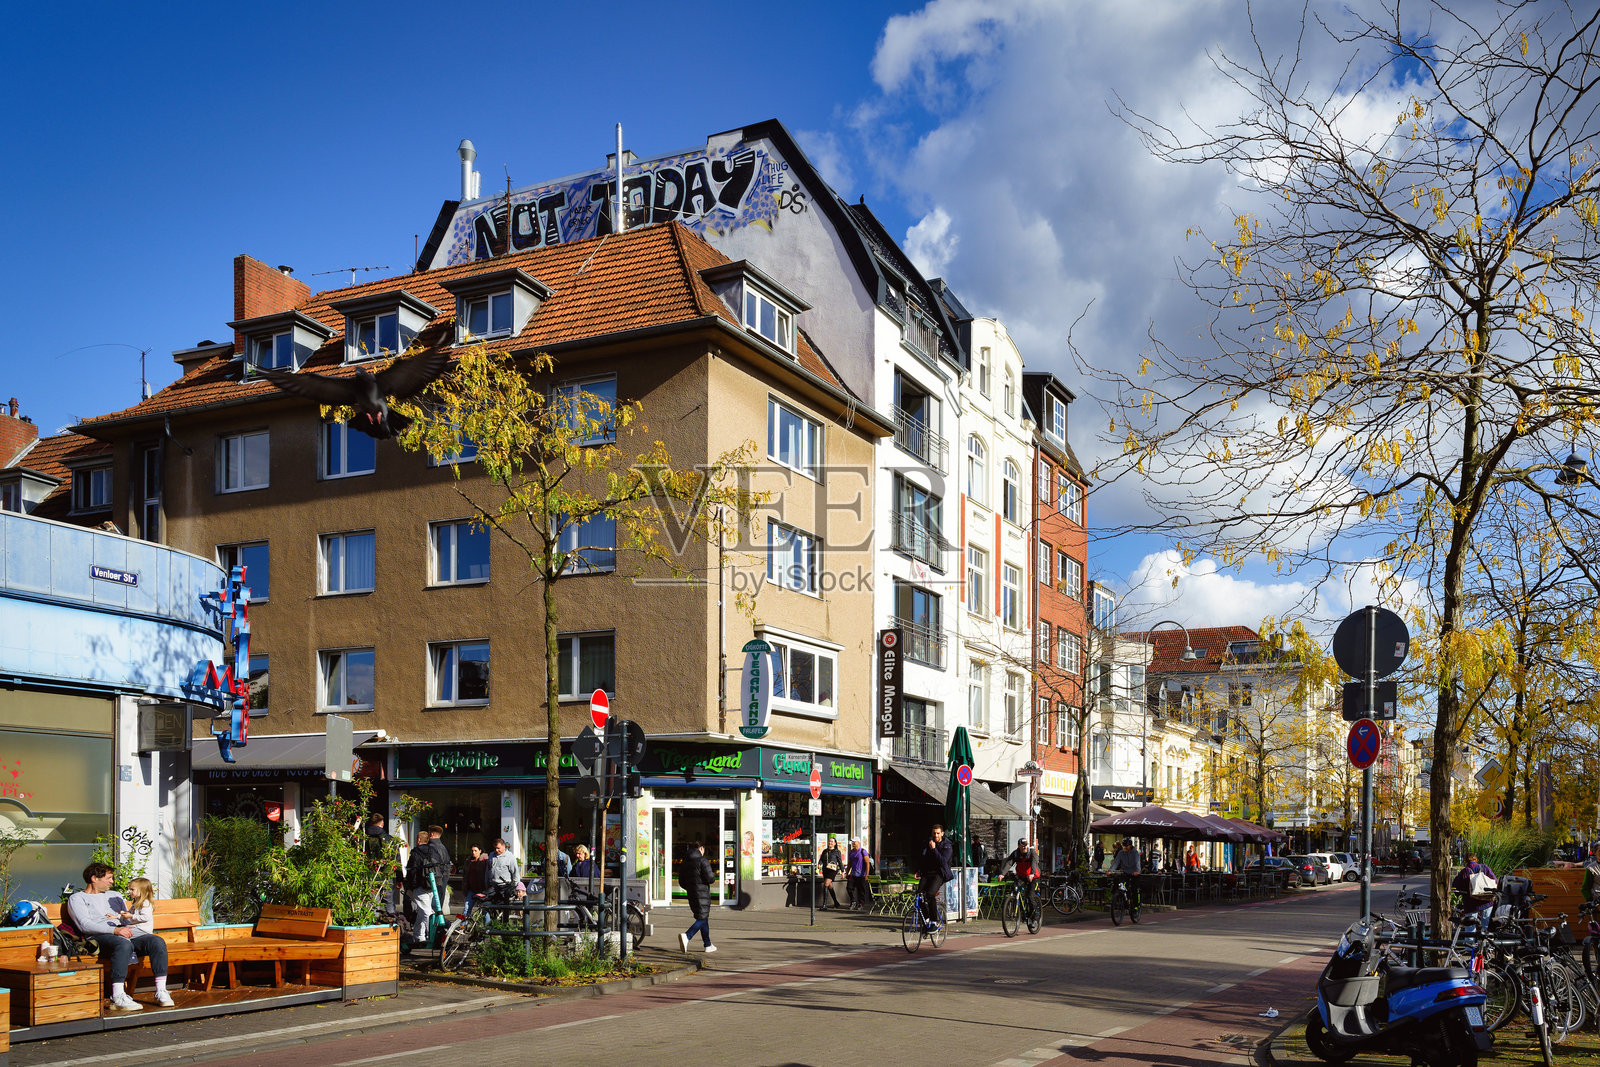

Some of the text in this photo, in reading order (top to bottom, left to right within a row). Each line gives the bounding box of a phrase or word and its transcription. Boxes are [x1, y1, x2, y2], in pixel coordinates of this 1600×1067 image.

[764, 161, 788, 173] THUG
[761, 172, 784, 185] LIFE
[472, 150, 757, 258] NOT TODAY
[94, 567, 136, 584] Venloer Str.
[748, 652, 760, 726] VEGANLAND
[881, 650, 896, 735] Elite Mangal
[742, 727, 764, 735] FALAFEL
[831, 761, 864, 780] falafel
